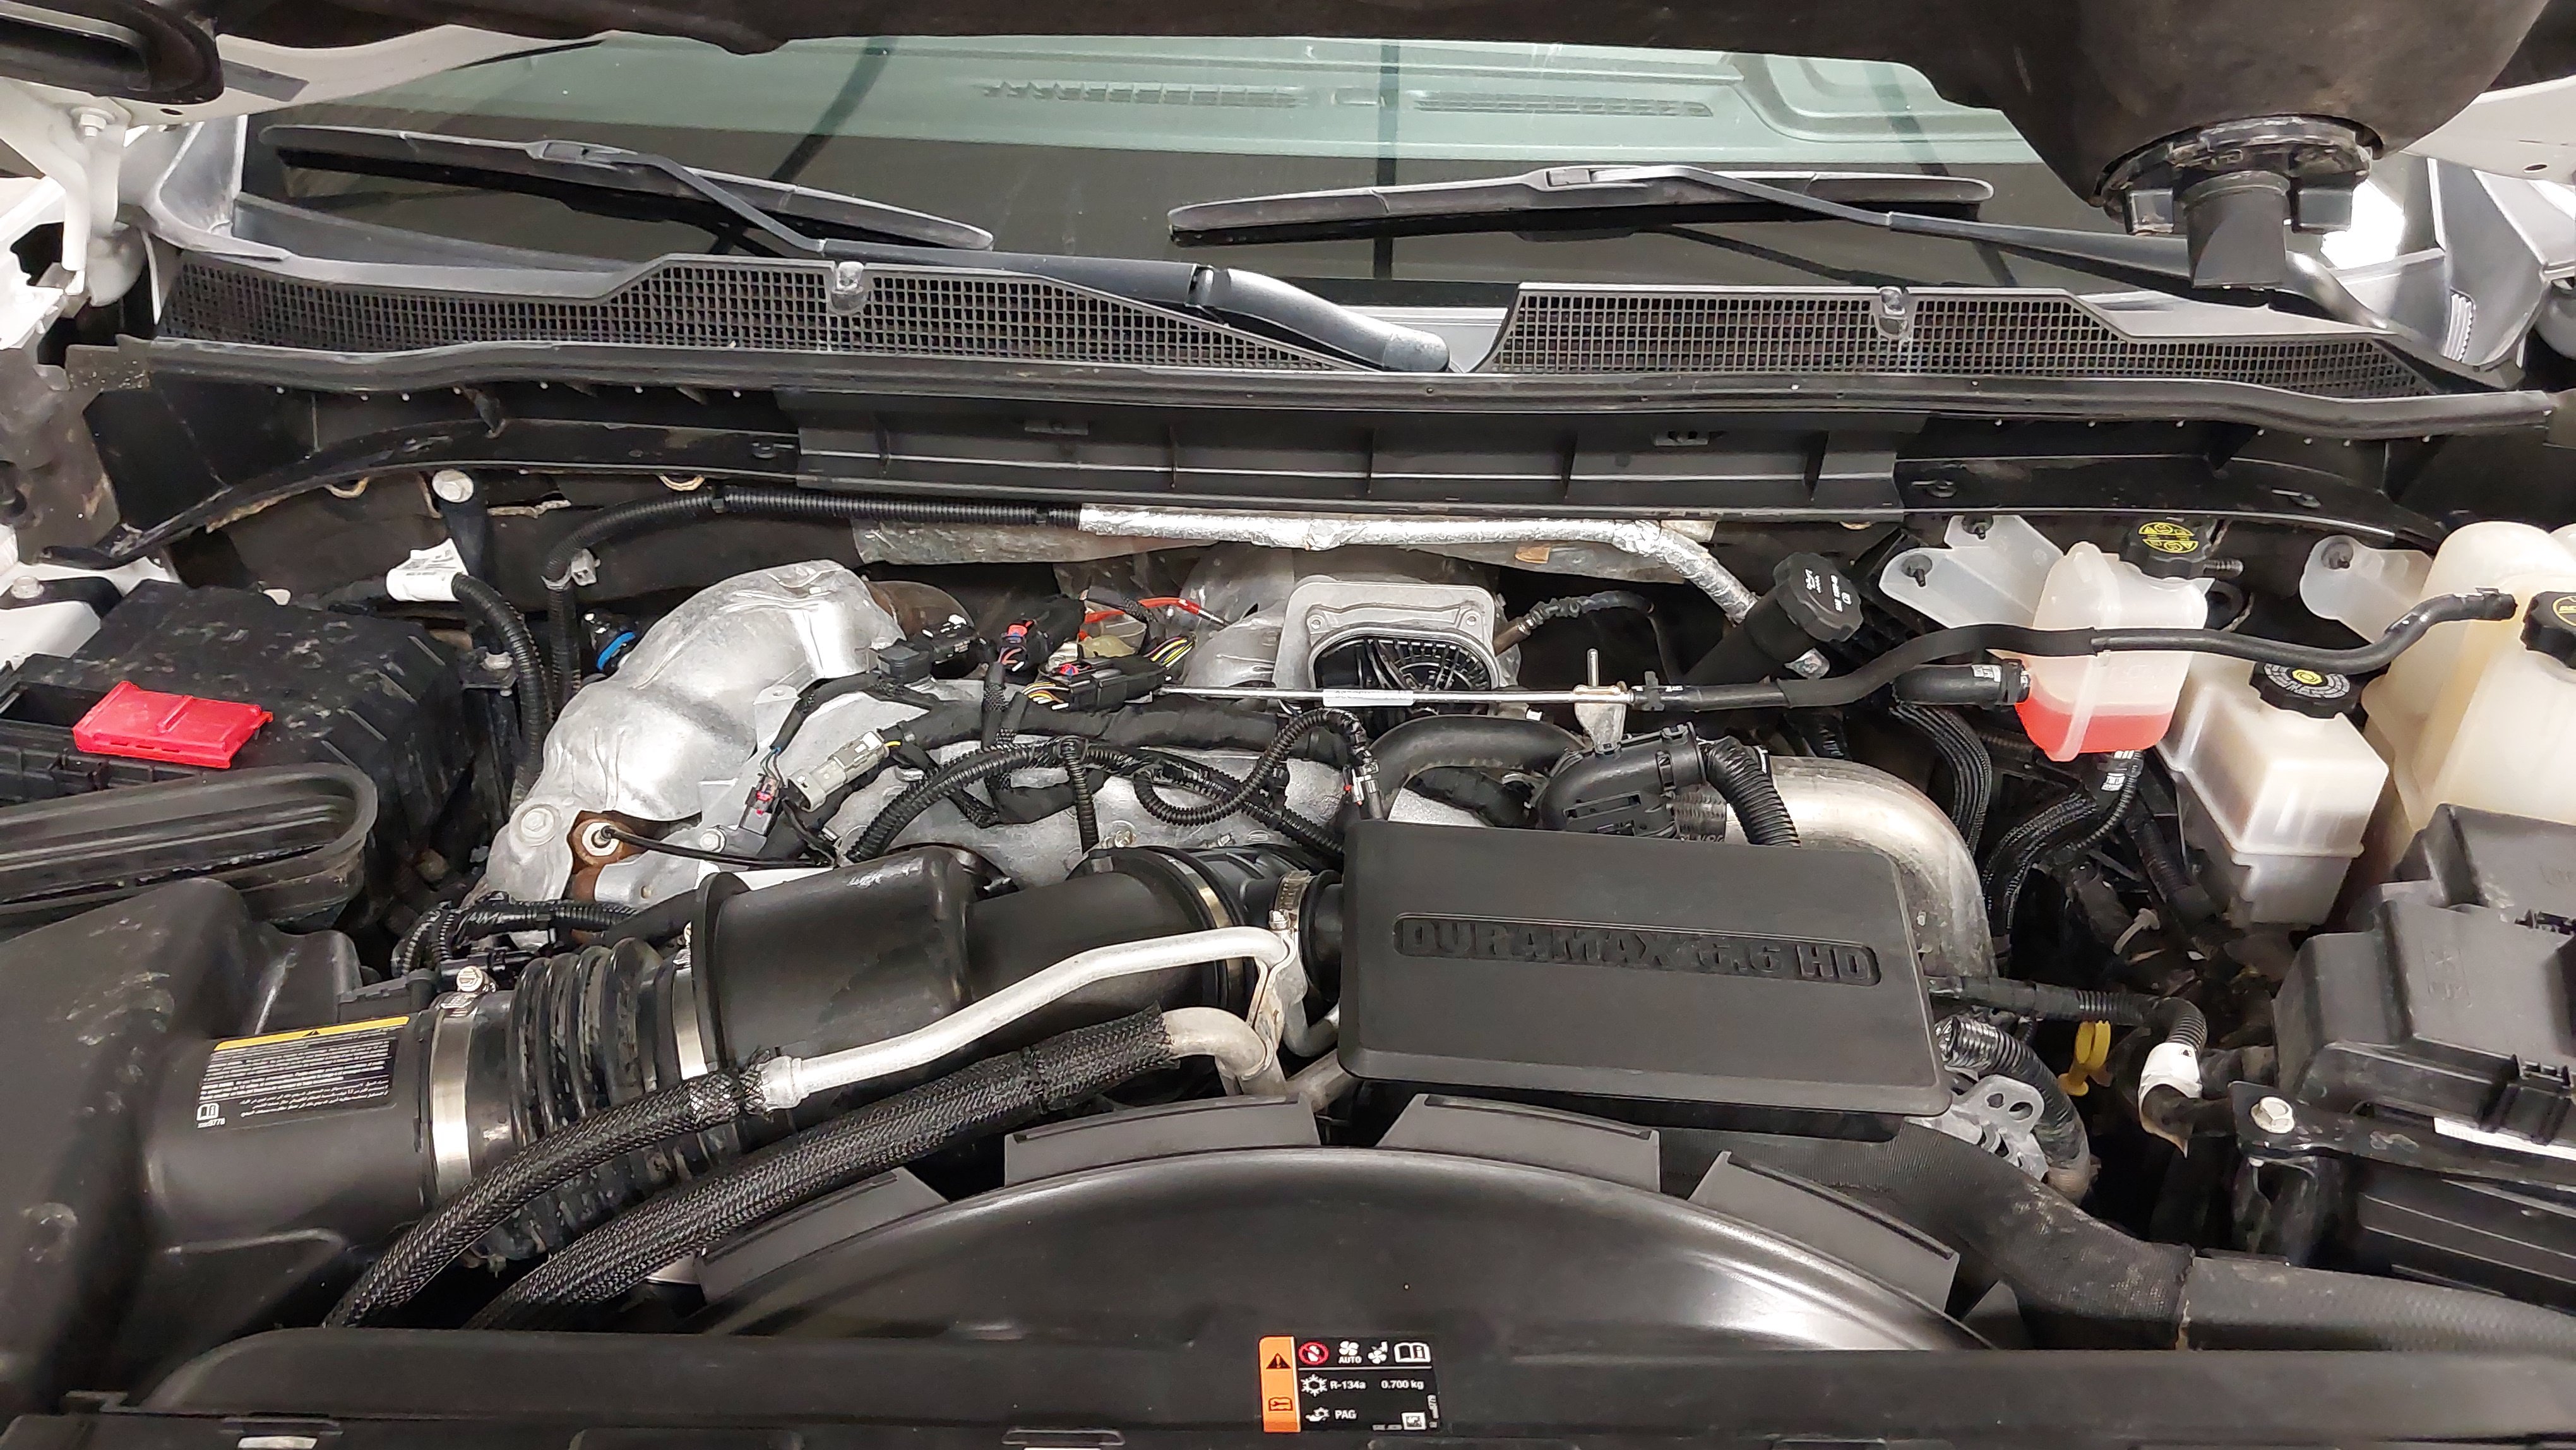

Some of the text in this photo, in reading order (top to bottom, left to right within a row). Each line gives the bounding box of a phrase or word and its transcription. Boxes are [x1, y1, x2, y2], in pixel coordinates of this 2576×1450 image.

[1401, 920, 1871, 980] DURAMAX 6.6 HD
[1339, 1356, 1362, 1364] AUTO
[1330, 1379, 1424, 1390] R-134a 0.700 kg
[1334, 1409, 1357, 1420] PAG
